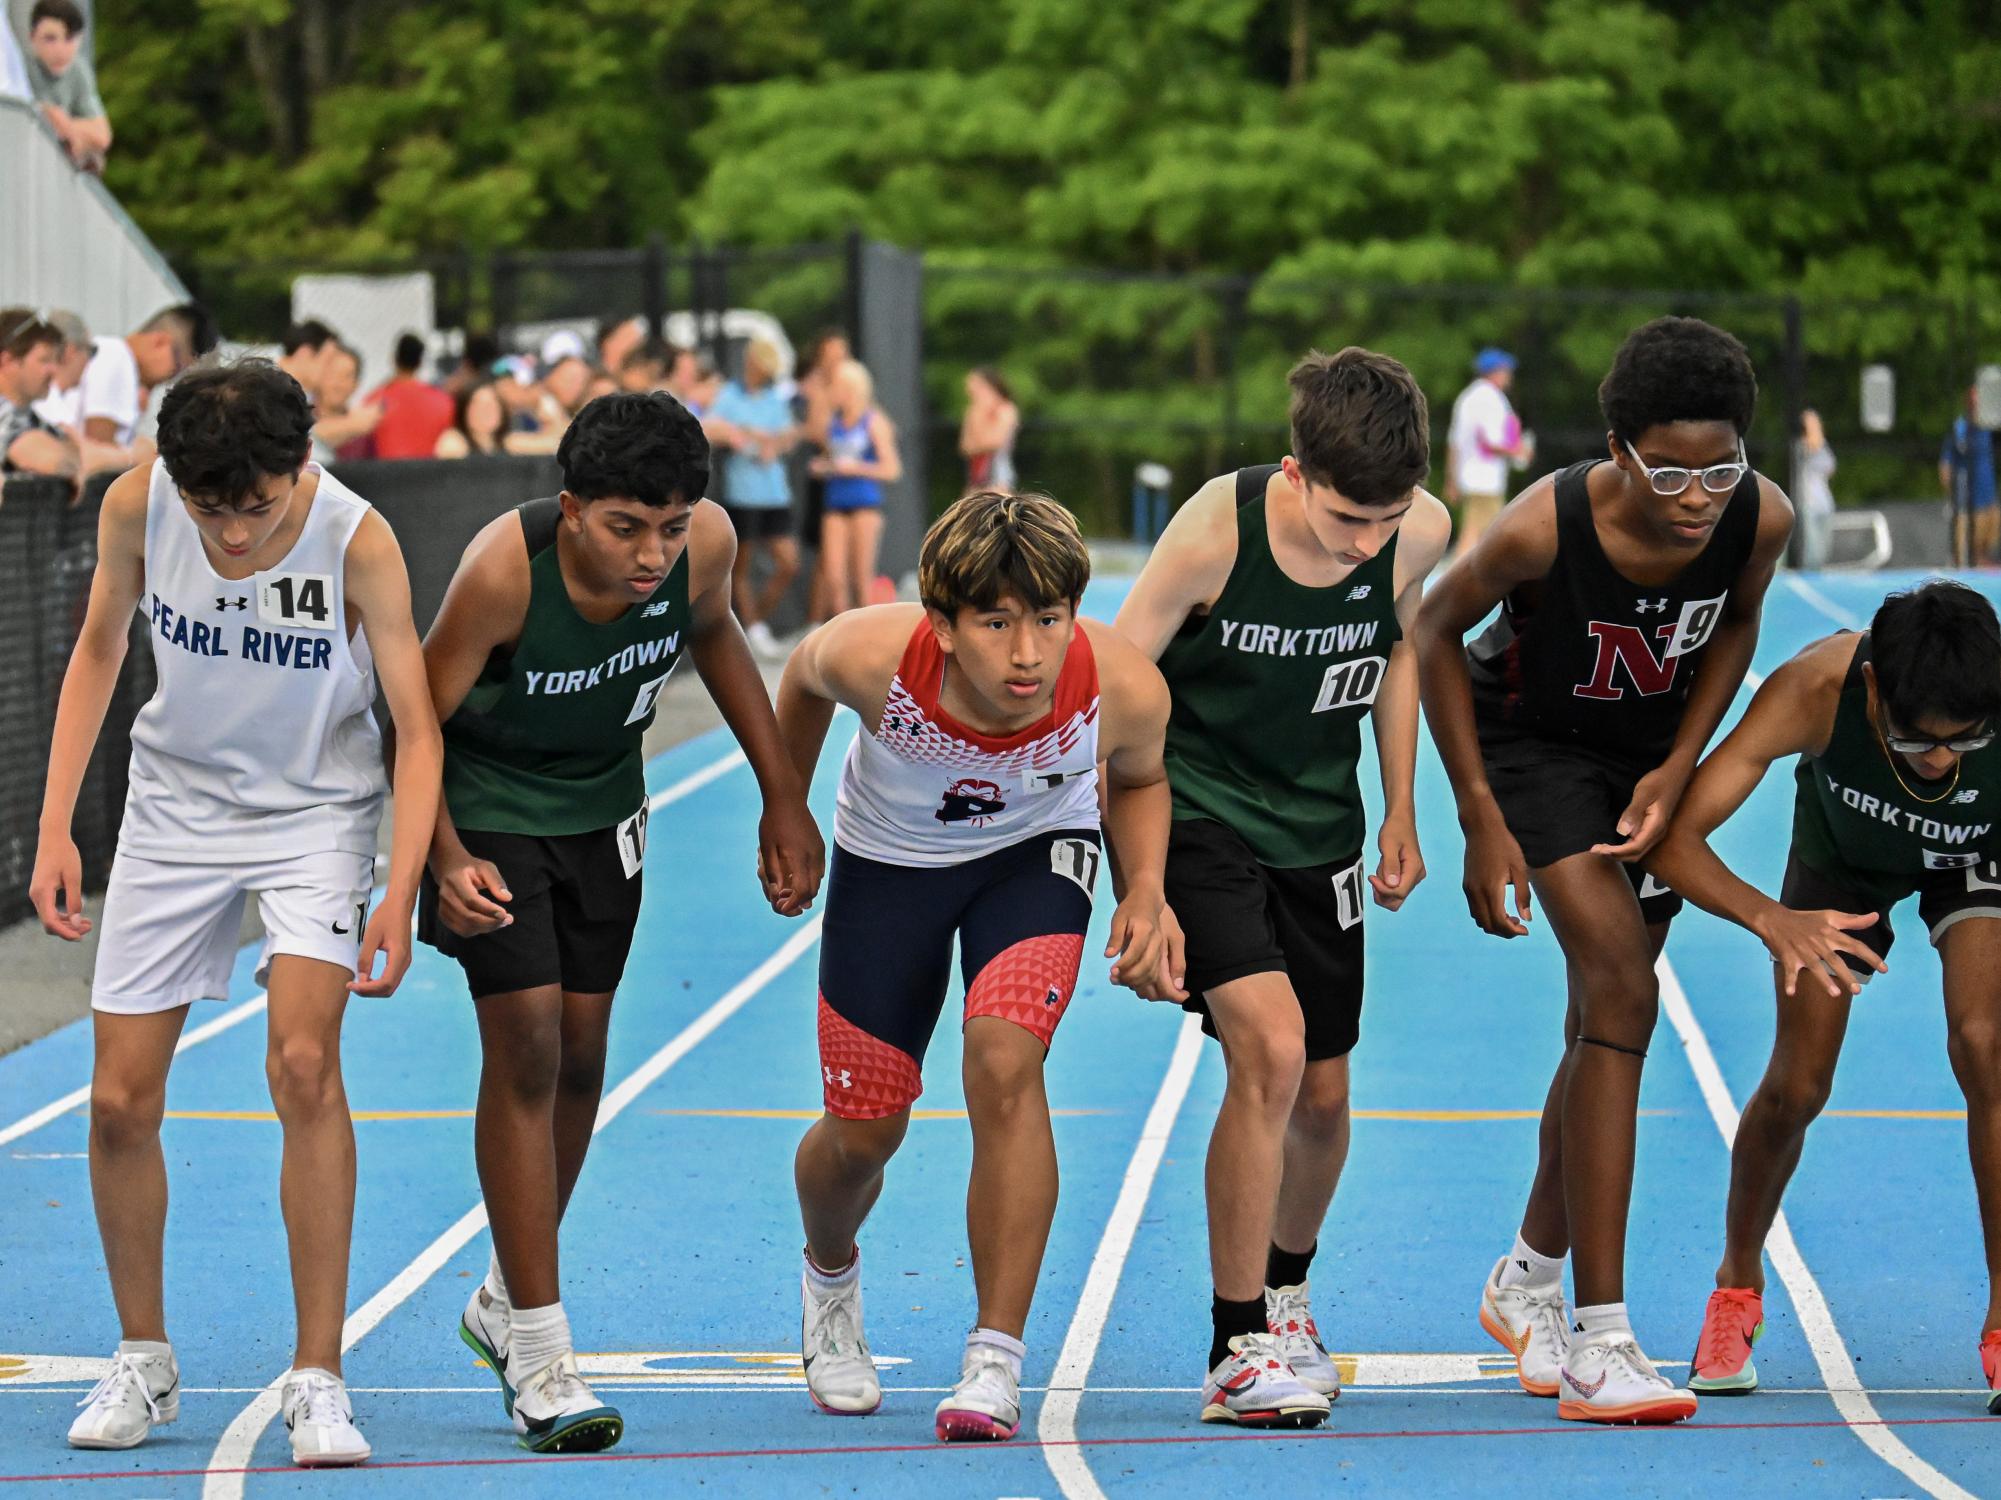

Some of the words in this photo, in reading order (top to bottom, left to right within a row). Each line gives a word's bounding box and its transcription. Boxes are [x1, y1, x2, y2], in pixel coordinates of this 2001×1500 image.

[270, 577, 329, 622] 14
[1680, 602, 1719, 650] 9
[151, 592, 229, 657] PEARL
[241, 626, 332, 671] RIVER
[1220, 619, 1379, 657] YORKTOWN
[525, 630, 680, 696] YORKTOWN
[1328, 660, 1380, 707] 10
[1573, 620, 1681, 700] N
[1825, 774, 1992, 845] YORKTOWN
[1066, 840, 1099, 896] 11
